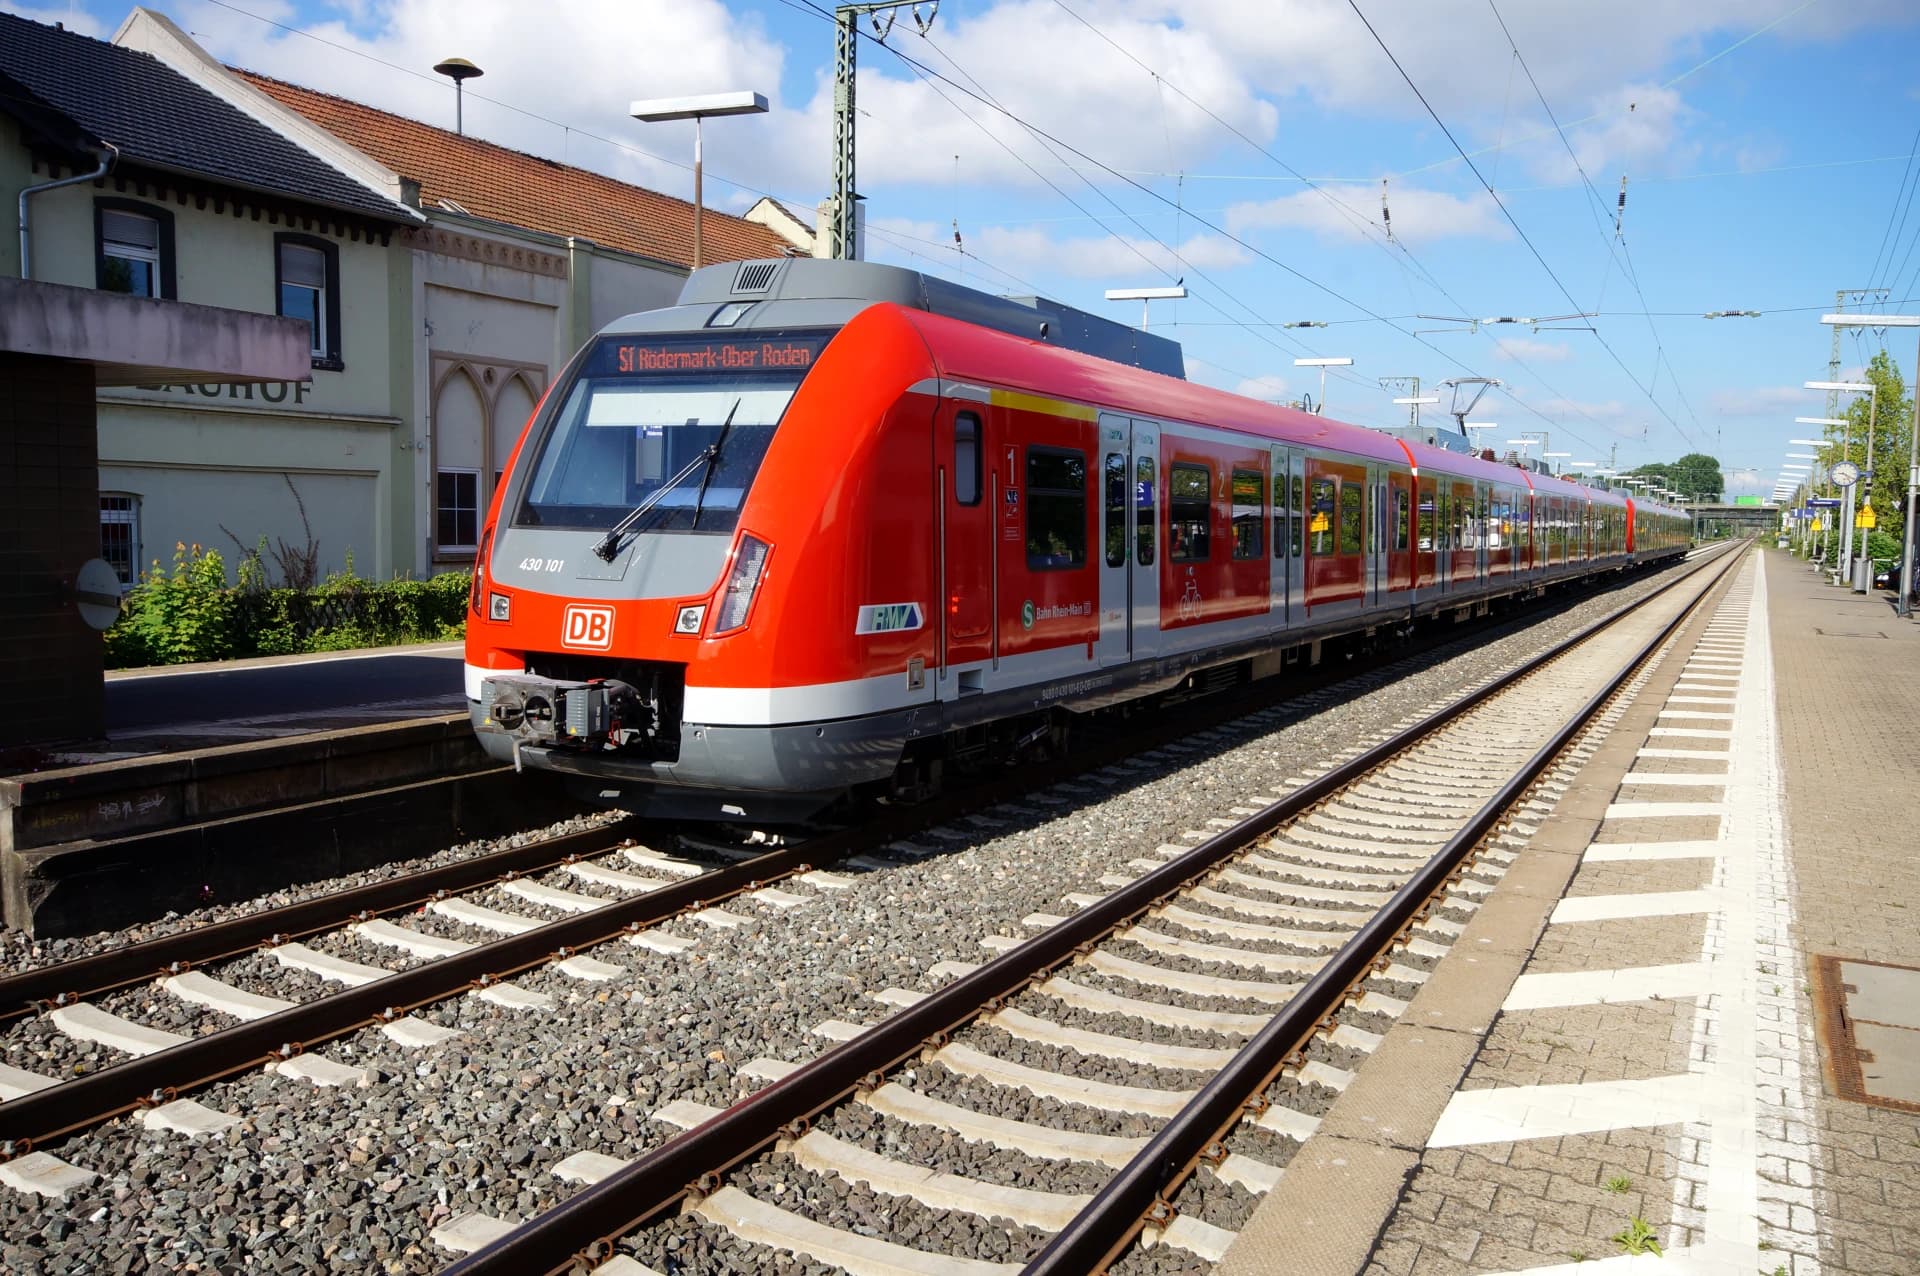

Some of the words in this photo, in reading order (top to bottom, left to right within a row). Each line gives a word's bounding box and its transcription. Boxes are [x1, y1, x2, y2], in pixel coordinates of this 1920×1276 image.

[618, 345, 635, 372] S1
[762, 343, 811, 367] Roden
[519, 557, 543, 572] 430
[544, 558, 564, 573] 101
[1036, 606, 1052, 621] Bahn
[1052, 602, 1083, 618] Rhein-Main
[569, 611, 607, 642] DB
